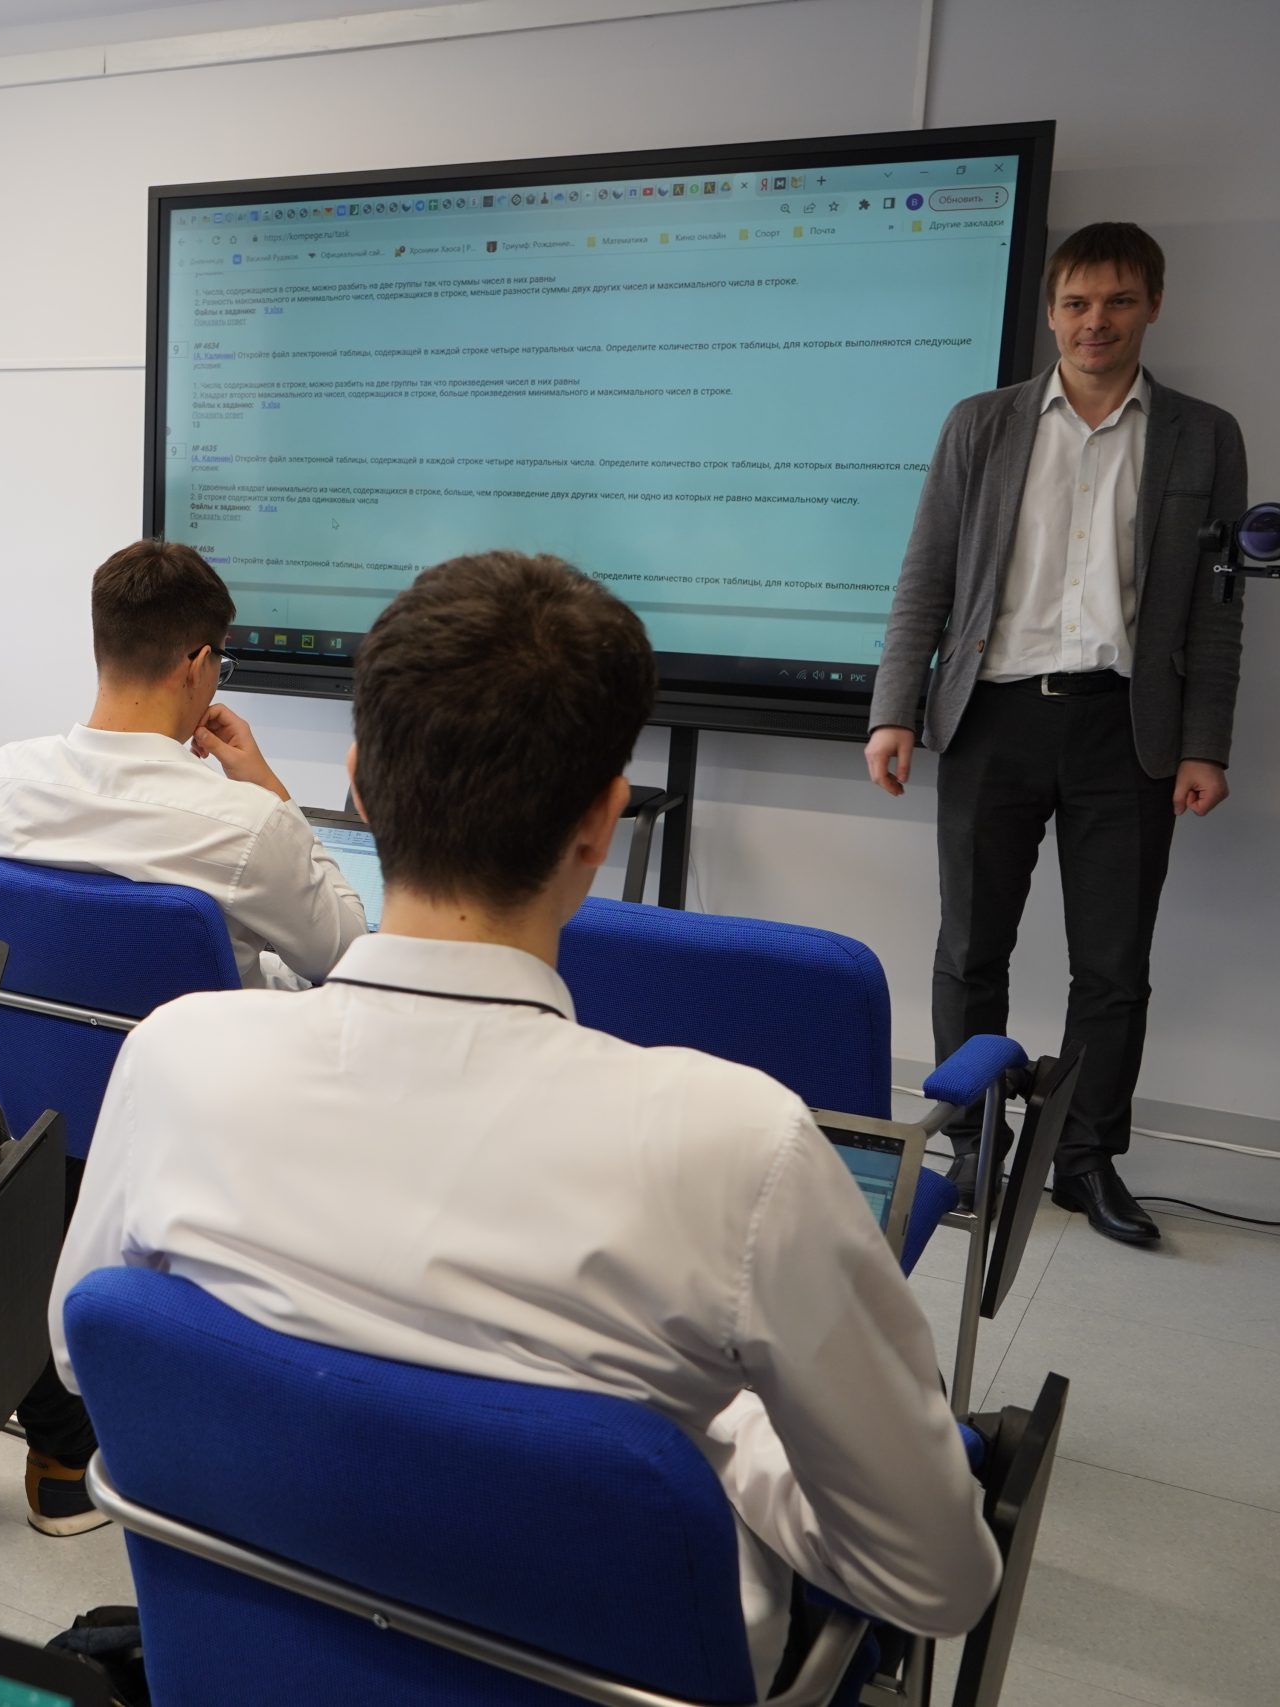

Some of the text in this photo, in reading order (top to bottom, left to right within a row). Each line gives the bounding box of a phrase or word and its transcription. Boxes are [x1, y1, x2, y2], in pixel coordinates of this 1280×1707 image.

[938, 195, 984, 205] Обновить
[810, 226, 836, 235] Почта
[929, 219, 1004, 231] Другие закладки
[675, 232, 726, 241] Кино онлайн
[755, 229, 780, 239] Спорт
[602, 236, 648, 245] Математика
[410, 245, 461, 255] Хроники Хаоса
[312, 284, 337, 292] можно
[338, 281, 368, 293] разбить
[379, 282, 394, 291] две
[394, 281, 423, 291] группы
[424, 280, 437, 288] так
[438, 280, 452, 288] что
[452, 279, 480, 289] суммы
[481, 278, 505, 286] чисел
[513, 277, 528, 285] них
[529, 276, 556, 286] равны
[296, 294, 351, 303] минимального
[376, 291, 433, 302] содержащихся
[470, 289, 502, 297] меньше
[502, 288, 540, 298] разности
[541, 286, 570, 297] суммы
[571, 286, 591, 296] двух
[592, 285, 621, 295] других
[622, 284, 648, 292] чисел
[657, 281, 727, 290] максимального
[728, 280, 755, 288] числа
[271, 350, 290, 361] файл
[292, 349, 338, 360] электронной
[374, 347, 422, 359] содержащей
[430, 346, 460, 357] каждой
[462, 347, 489, 357] строке
[490, 347, 520, 356] четыре
[521, 345, 575, 356] натуральных
[606, 342, 657, 354] Определите
[658, 343, 710, 351] количество
[711, 342, 737, 352] строк
[783, 341, 801, 350] для
[803, 340, 843, 350] которых
[845, 338, 912, 347] выполняются
[914, 337, 972, 348] следующие
[334, 379, 364, 390] разбить
[365, 380, 375, 388] на
[376, 380, 390, 389] две
[391, 380, 418, 390] группы
[448, 379, 504, 389] произведения
[537, 378, 552, 386] них
[553, 378, 581, 388] равны
[348, 391, 403, 400] содержащихся
[439, 389, 469, 398] больше
[470, 390, 527, 399] произведения
[528, 389, 589, 397] минимального
[597, 388, 664, 396] максимального
[665, 388, 692, 396] чисел
[268, 455, 287, 466] файл
[288, 455, 334, 466] электронной
[370, 455, 417, 467] содержащей
[426, 456, 455, 466] каждой
[456, 458, 484, 467] строке
[485, 458, 514, 468] четыре
[516, 458, 568, 468] натуральных
[598, 458, 649, 469] Определите
[651, 460, 702, 468] количество
[703, 461, 729, 470] строк
[774, 462, 792, 470] для
[793, 462, 833, 472] которых
[835, 462, 901, 471] выполняются
[266, 485, 318, 494] минимального
[319, 486, 328, 494] из
[352, 487, 408, 497] содержащихся
[492, 490, 550, 500] произведение
[550, 491, 570, 500] двух
[570, 491, 598, 501] других
[628, 492, 639, 500] ни
[640, 493, 662, 502] одно
[663, 493, 673, 501] из
[674, 493, 712, 503] которых
[713, 494, 724, 502] не
[725, 494, 753, 504] равно
[754, 495, 829, 506] максимальному
[286, 494, 297, 503] бы
[297, 496, 311, 505] два
[312, 496, 356, 506] одинаковых
[357, 497, 379, 505] числа
[265, 557, 284, 568] файл
[285, 558, 330, 570] электронной
[366, 561, 413, 573] содержащей
[593, 571, 642, 583] Определите
[643, 574, 693, 583] количество
[695, 576, 720, 586] строк
[765, 579, 782, 588] для
[784, 580, 823, 591] которых
[825, 582, 890, 591] выполняются
[850, 673, 867, 683] РУС
